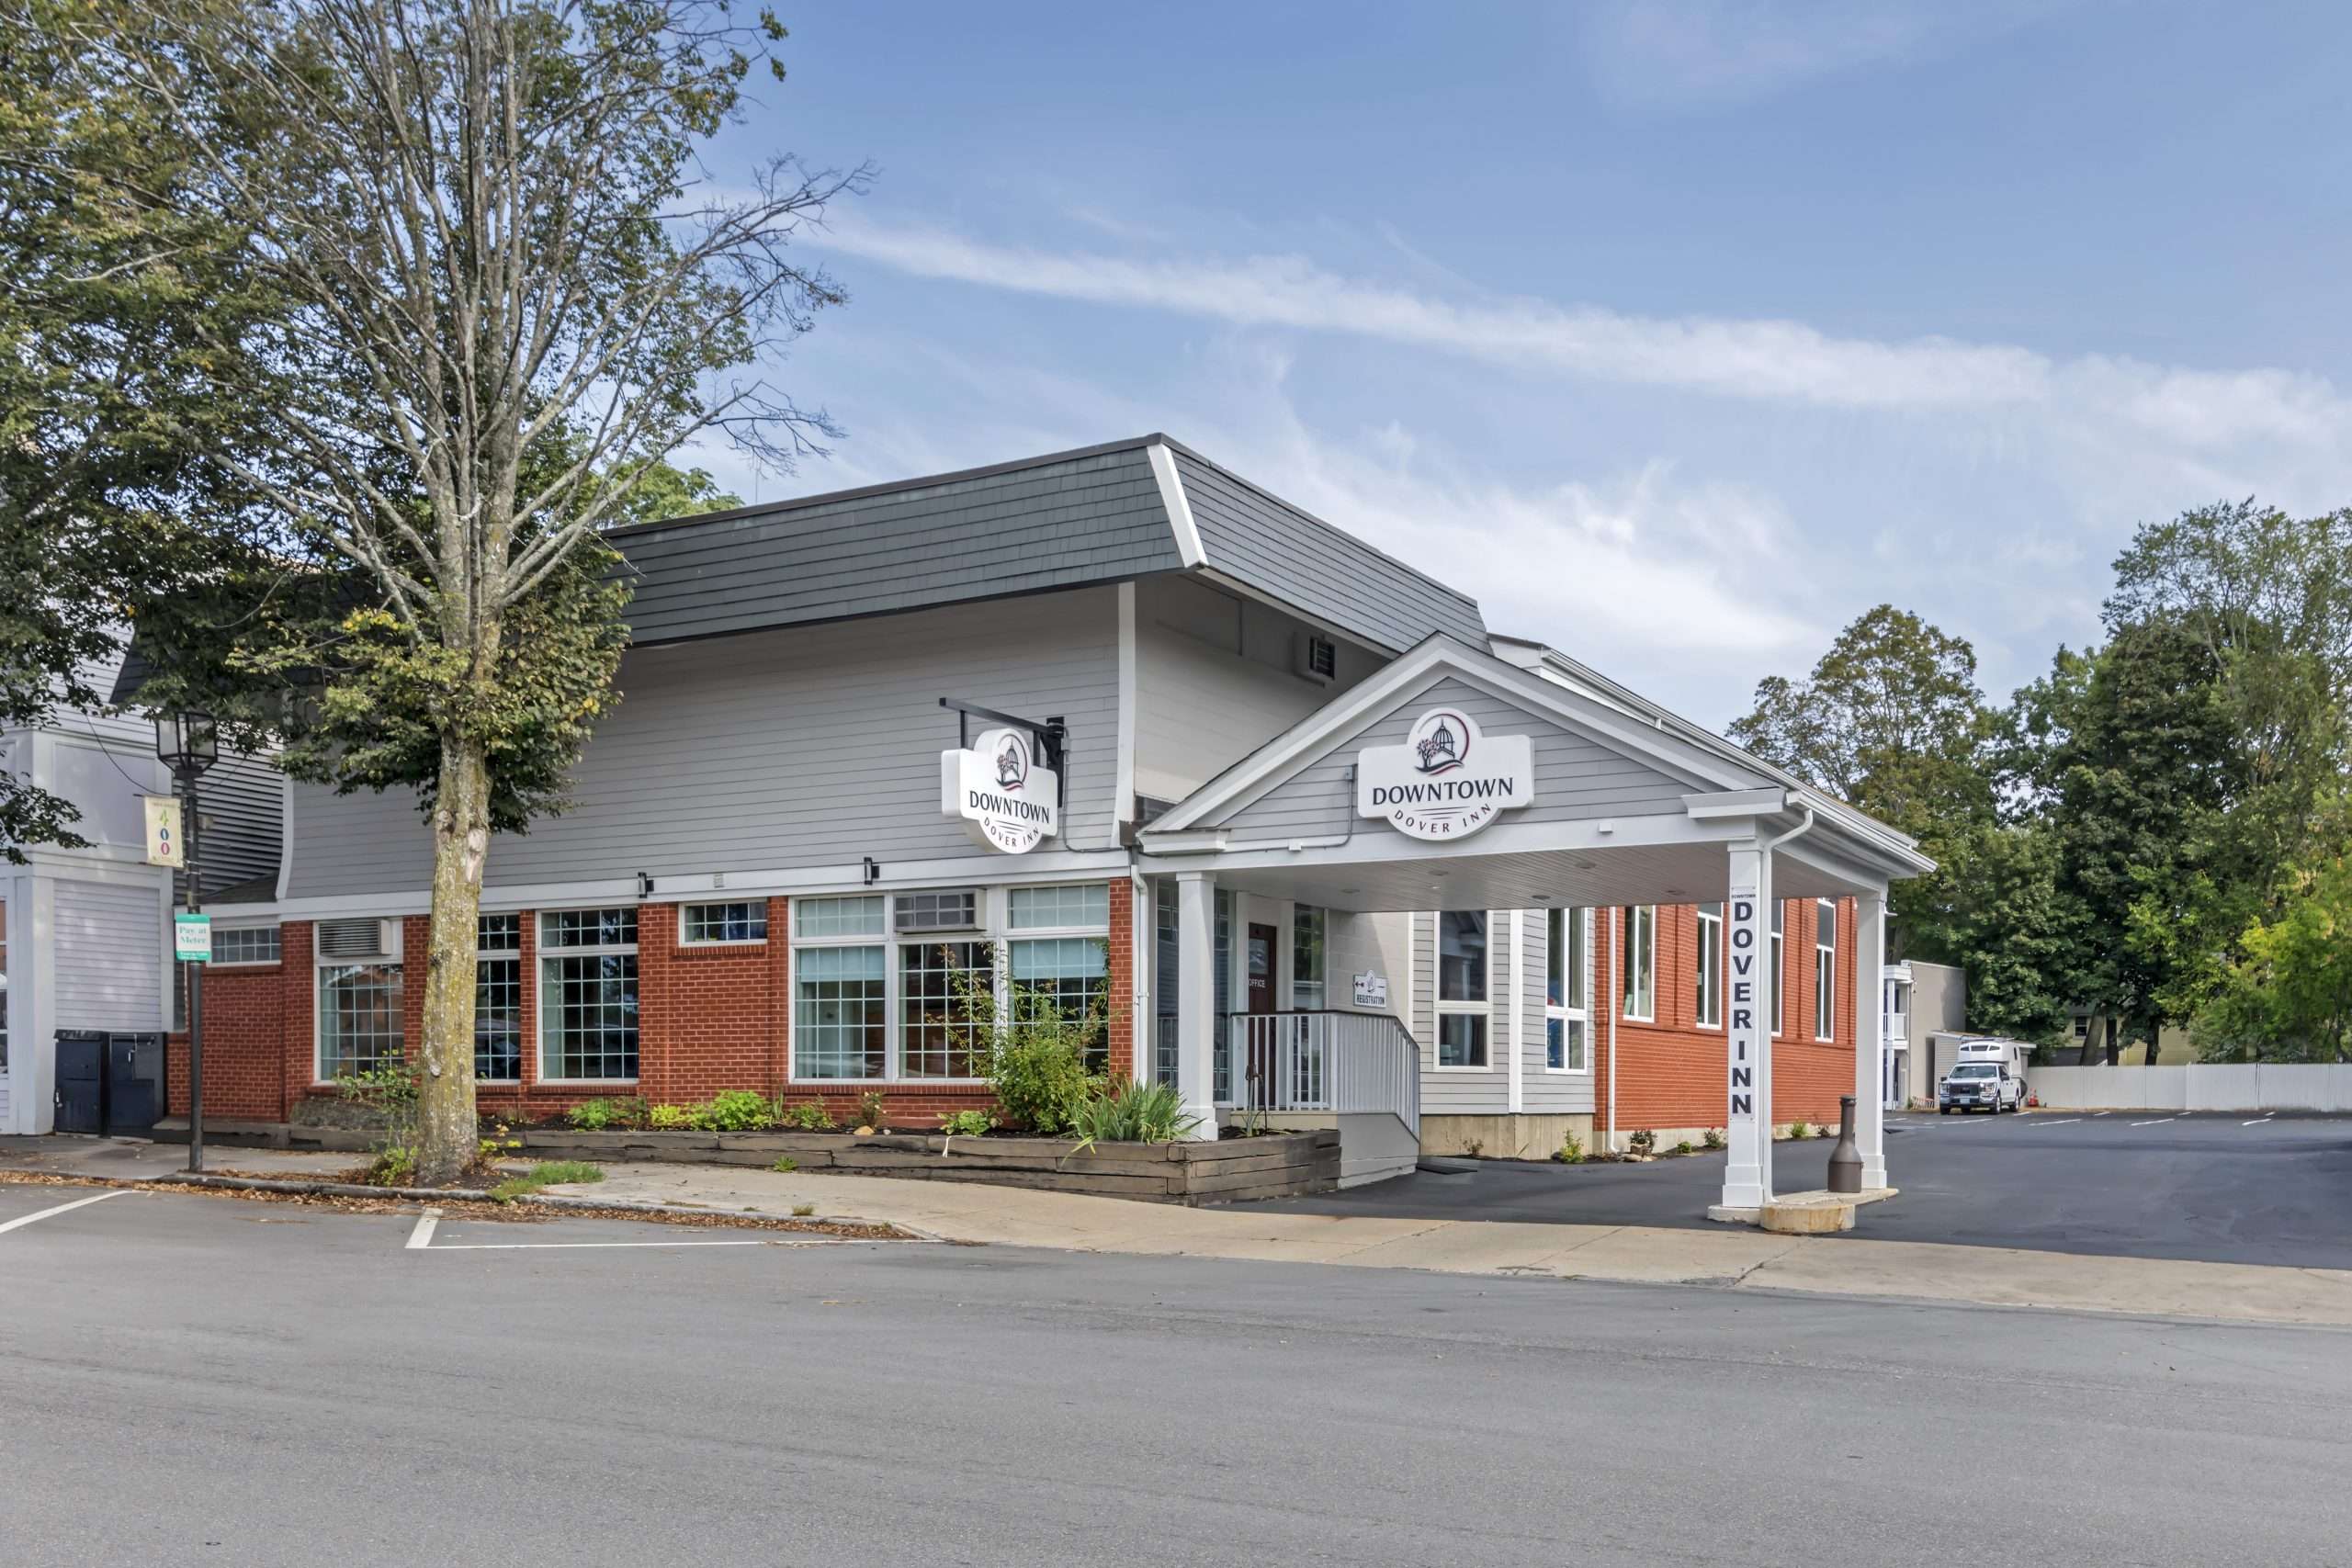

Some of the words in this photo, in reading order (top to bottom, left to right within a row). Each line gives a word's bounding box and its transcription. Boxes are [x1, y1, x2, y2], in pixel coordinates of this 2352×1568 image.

[1373, 777, 1513, 806] DOWNTOWN
[969, 790, 1050, 824] DOWNTOWN
[1395, 809, 1451, 833] DOVER
[1463, 804, 1492, 827] INN
[984, 817, 1017, 847] DOVER
[1023, 829, 1039, 845] INN
[179, 926, 195, 935] Pay
[198, 926, 207, 934] at
[180, 936, 207, 944] Meter
[1733, 902, 1753, 1030] DOVER
[1356, 994, 1385, 1005] REGISTRATION
[1732, 1041, 1752, 1114] INN
